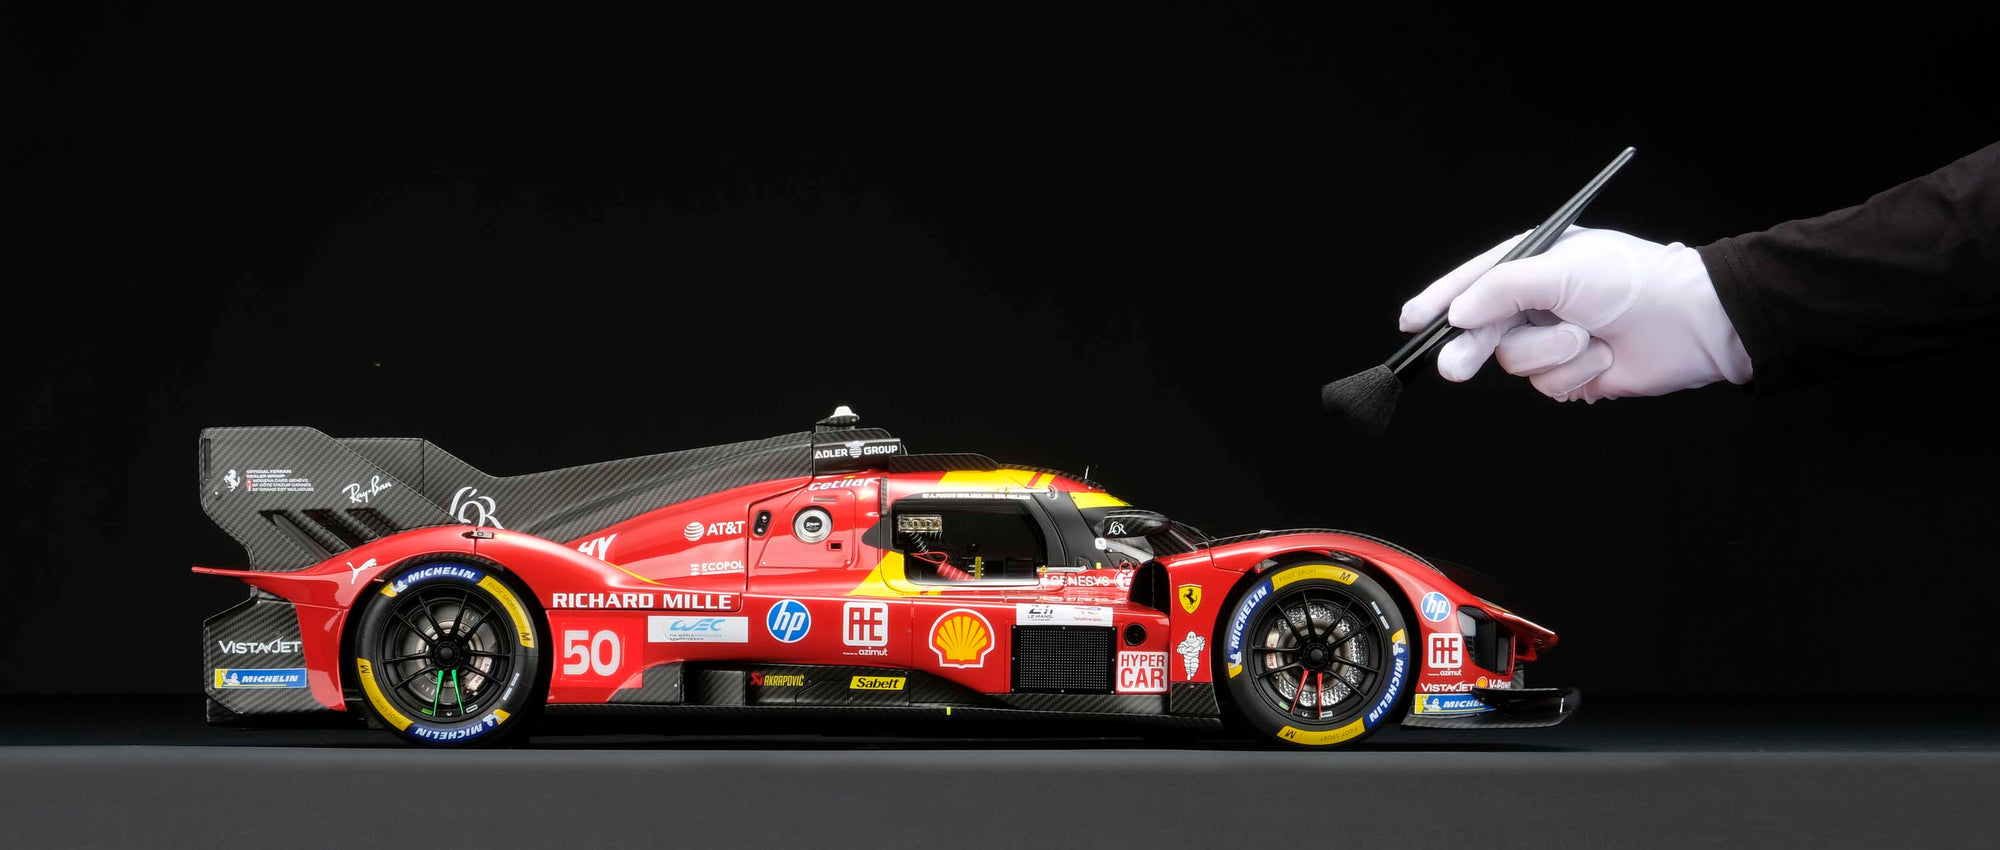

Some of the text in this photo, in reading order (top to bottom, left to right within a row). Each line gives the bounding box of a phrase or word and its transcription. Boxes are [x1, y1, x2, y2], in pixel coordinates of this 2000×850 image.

[814, 445, 898, 459] ADLER GROUP
[342, 475, 392, 503] Ray-Ban
[707, 521, 745, 537] AT&T
[701, 560, 744, 572] ECOPOL
[408, 566, 475, 583] MICHELIN
[1051, 575, 1110, 587] GENESYS
[1340, 571, 1352, 582] M
[552, 592, 732, 610] RICHARD MILLE
[1425, 592, 1447, 621] hp
[772, 600, 806, 641] hp
[1231, 585, 1268, 649] MICHELIN
[670, 618, 726, 631] WEC
[520, 632, 531, 641] M
[563, 629, 621, 677] 50
[858, 646, 888, 656] azimut
[1121, 654, 1165, 667] HYPER
[360, 664, 371, 674] M
[1440, 668, 1462, 676] azimut
[241, 675, 299, 683] MICHELIN
[856, 677, 900, 689] Sabelt
[1120, 667, 1165, 688] CAR
[1368, 658, 1405, 722] MICHELIN
[415, 723, 483, 740] MICHELIN
[1284, 729, 1297, 739] M
